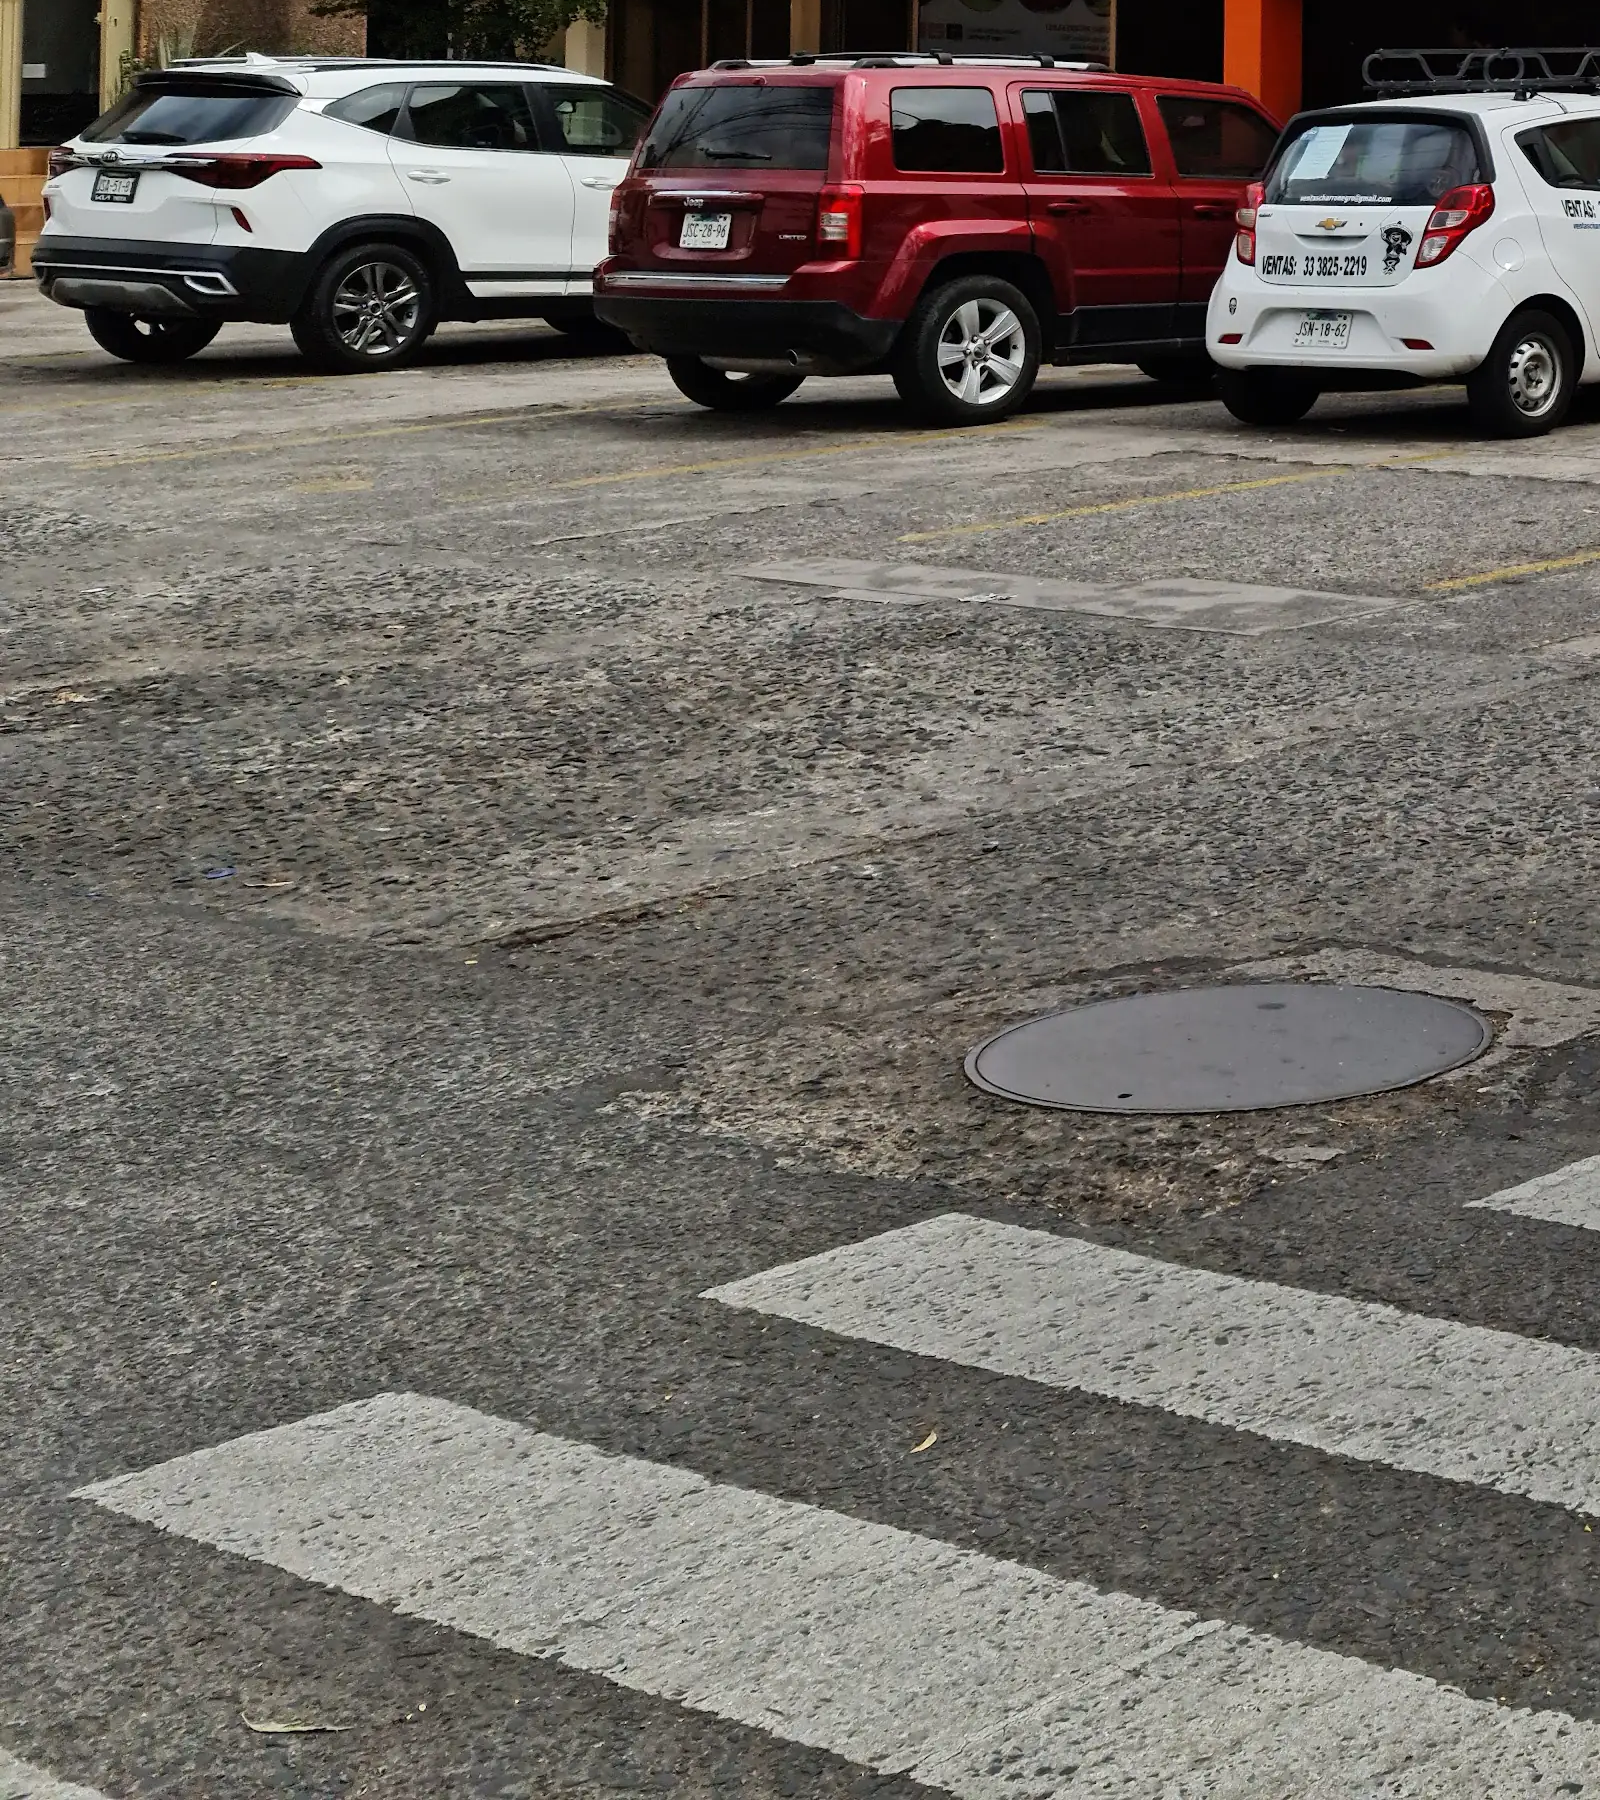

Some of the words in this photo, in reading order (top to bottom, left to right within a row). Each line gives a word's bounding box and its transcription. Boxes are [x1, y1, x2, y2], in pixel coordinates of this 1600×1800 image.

[683, 197, 704, 208] Jeep
[1300, 194, 1393, 204] ventascharronegro@gmail.com
[1560, 199, 1597, 218] VENTAS:
[683, 223, 726, 239] JSC-28-96
[1261, 255, 1298, 276] VENTAS:
[1303, 255, 1314, 277] 33
[1317, 255, 1368, 277] 3825-2219
[1295, 321, 1348, 338] JSN-18-62
